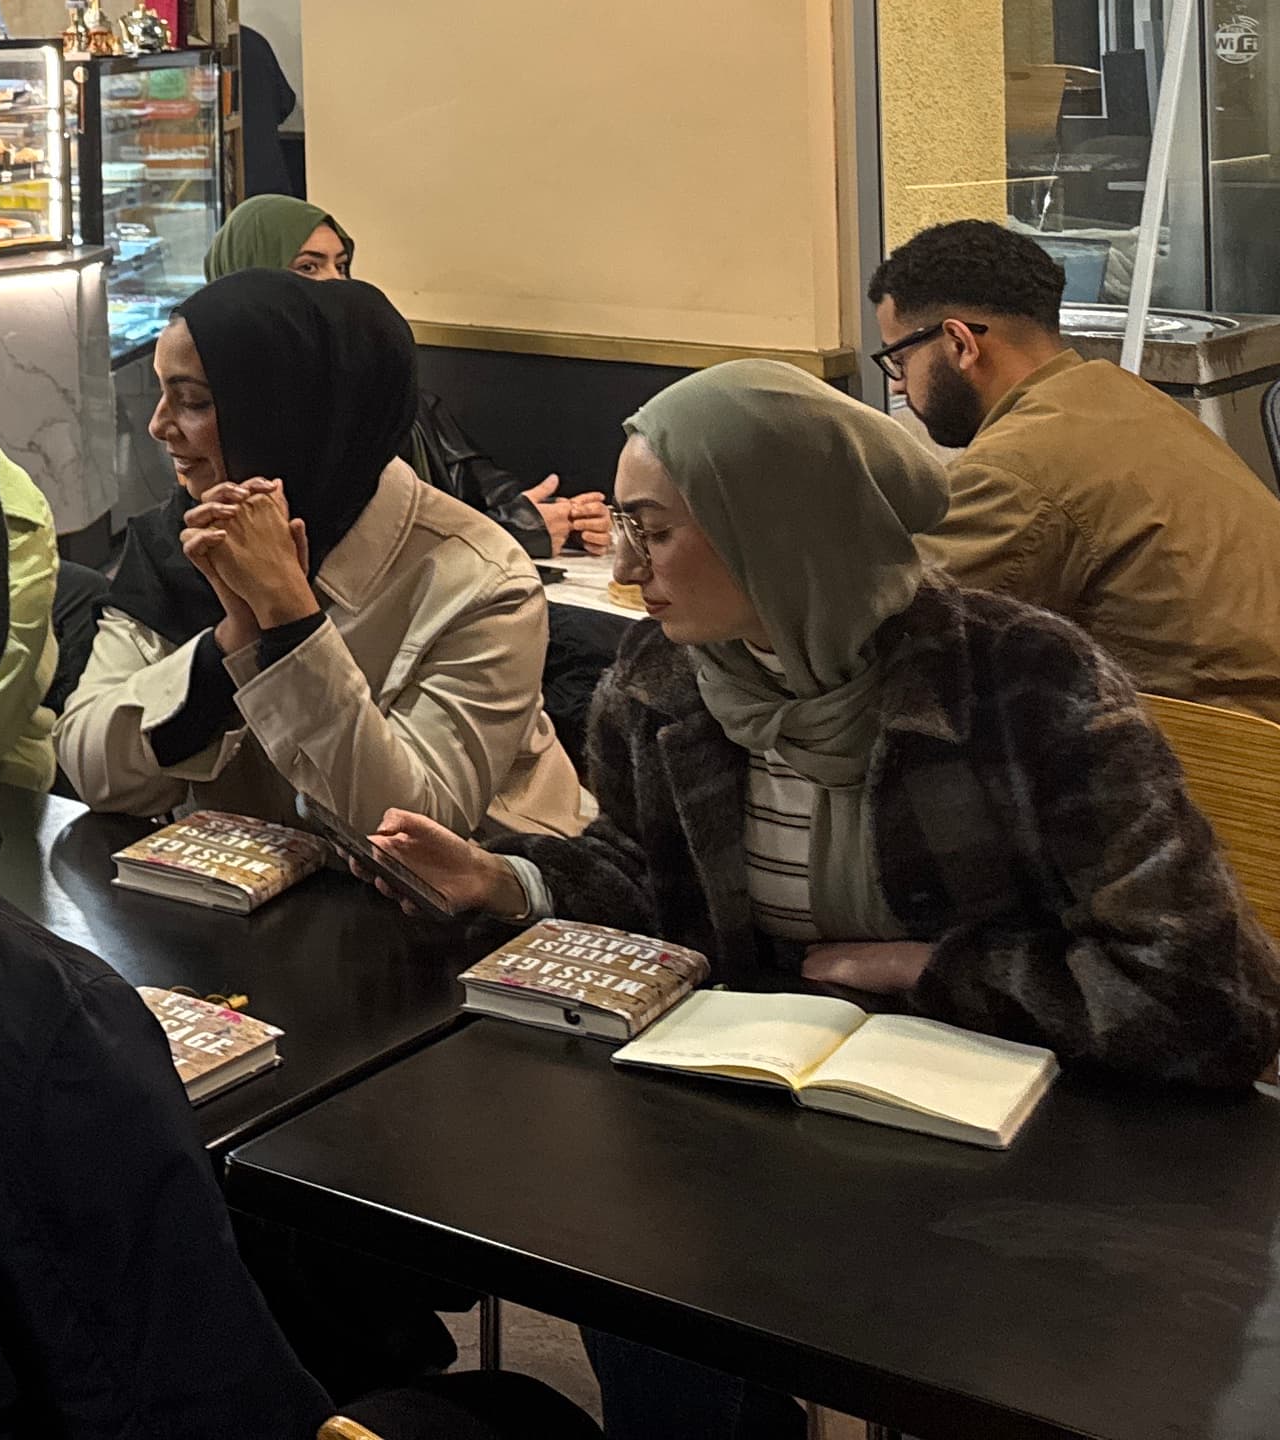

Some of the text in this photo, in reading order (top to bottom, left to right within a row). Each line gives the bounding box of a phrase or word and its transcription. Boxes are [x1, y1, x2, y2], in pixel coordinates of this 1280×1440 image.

[147, 837, 271, 874] MESSAGE
[177, 856, 208, 870] THE
[526, 938, 659, 976] TA-NEHISI
[558, 931, 657, 959] COATES
[497, 953, 648, 996] MESSAGE
[538, 976, 575, 991] THE
